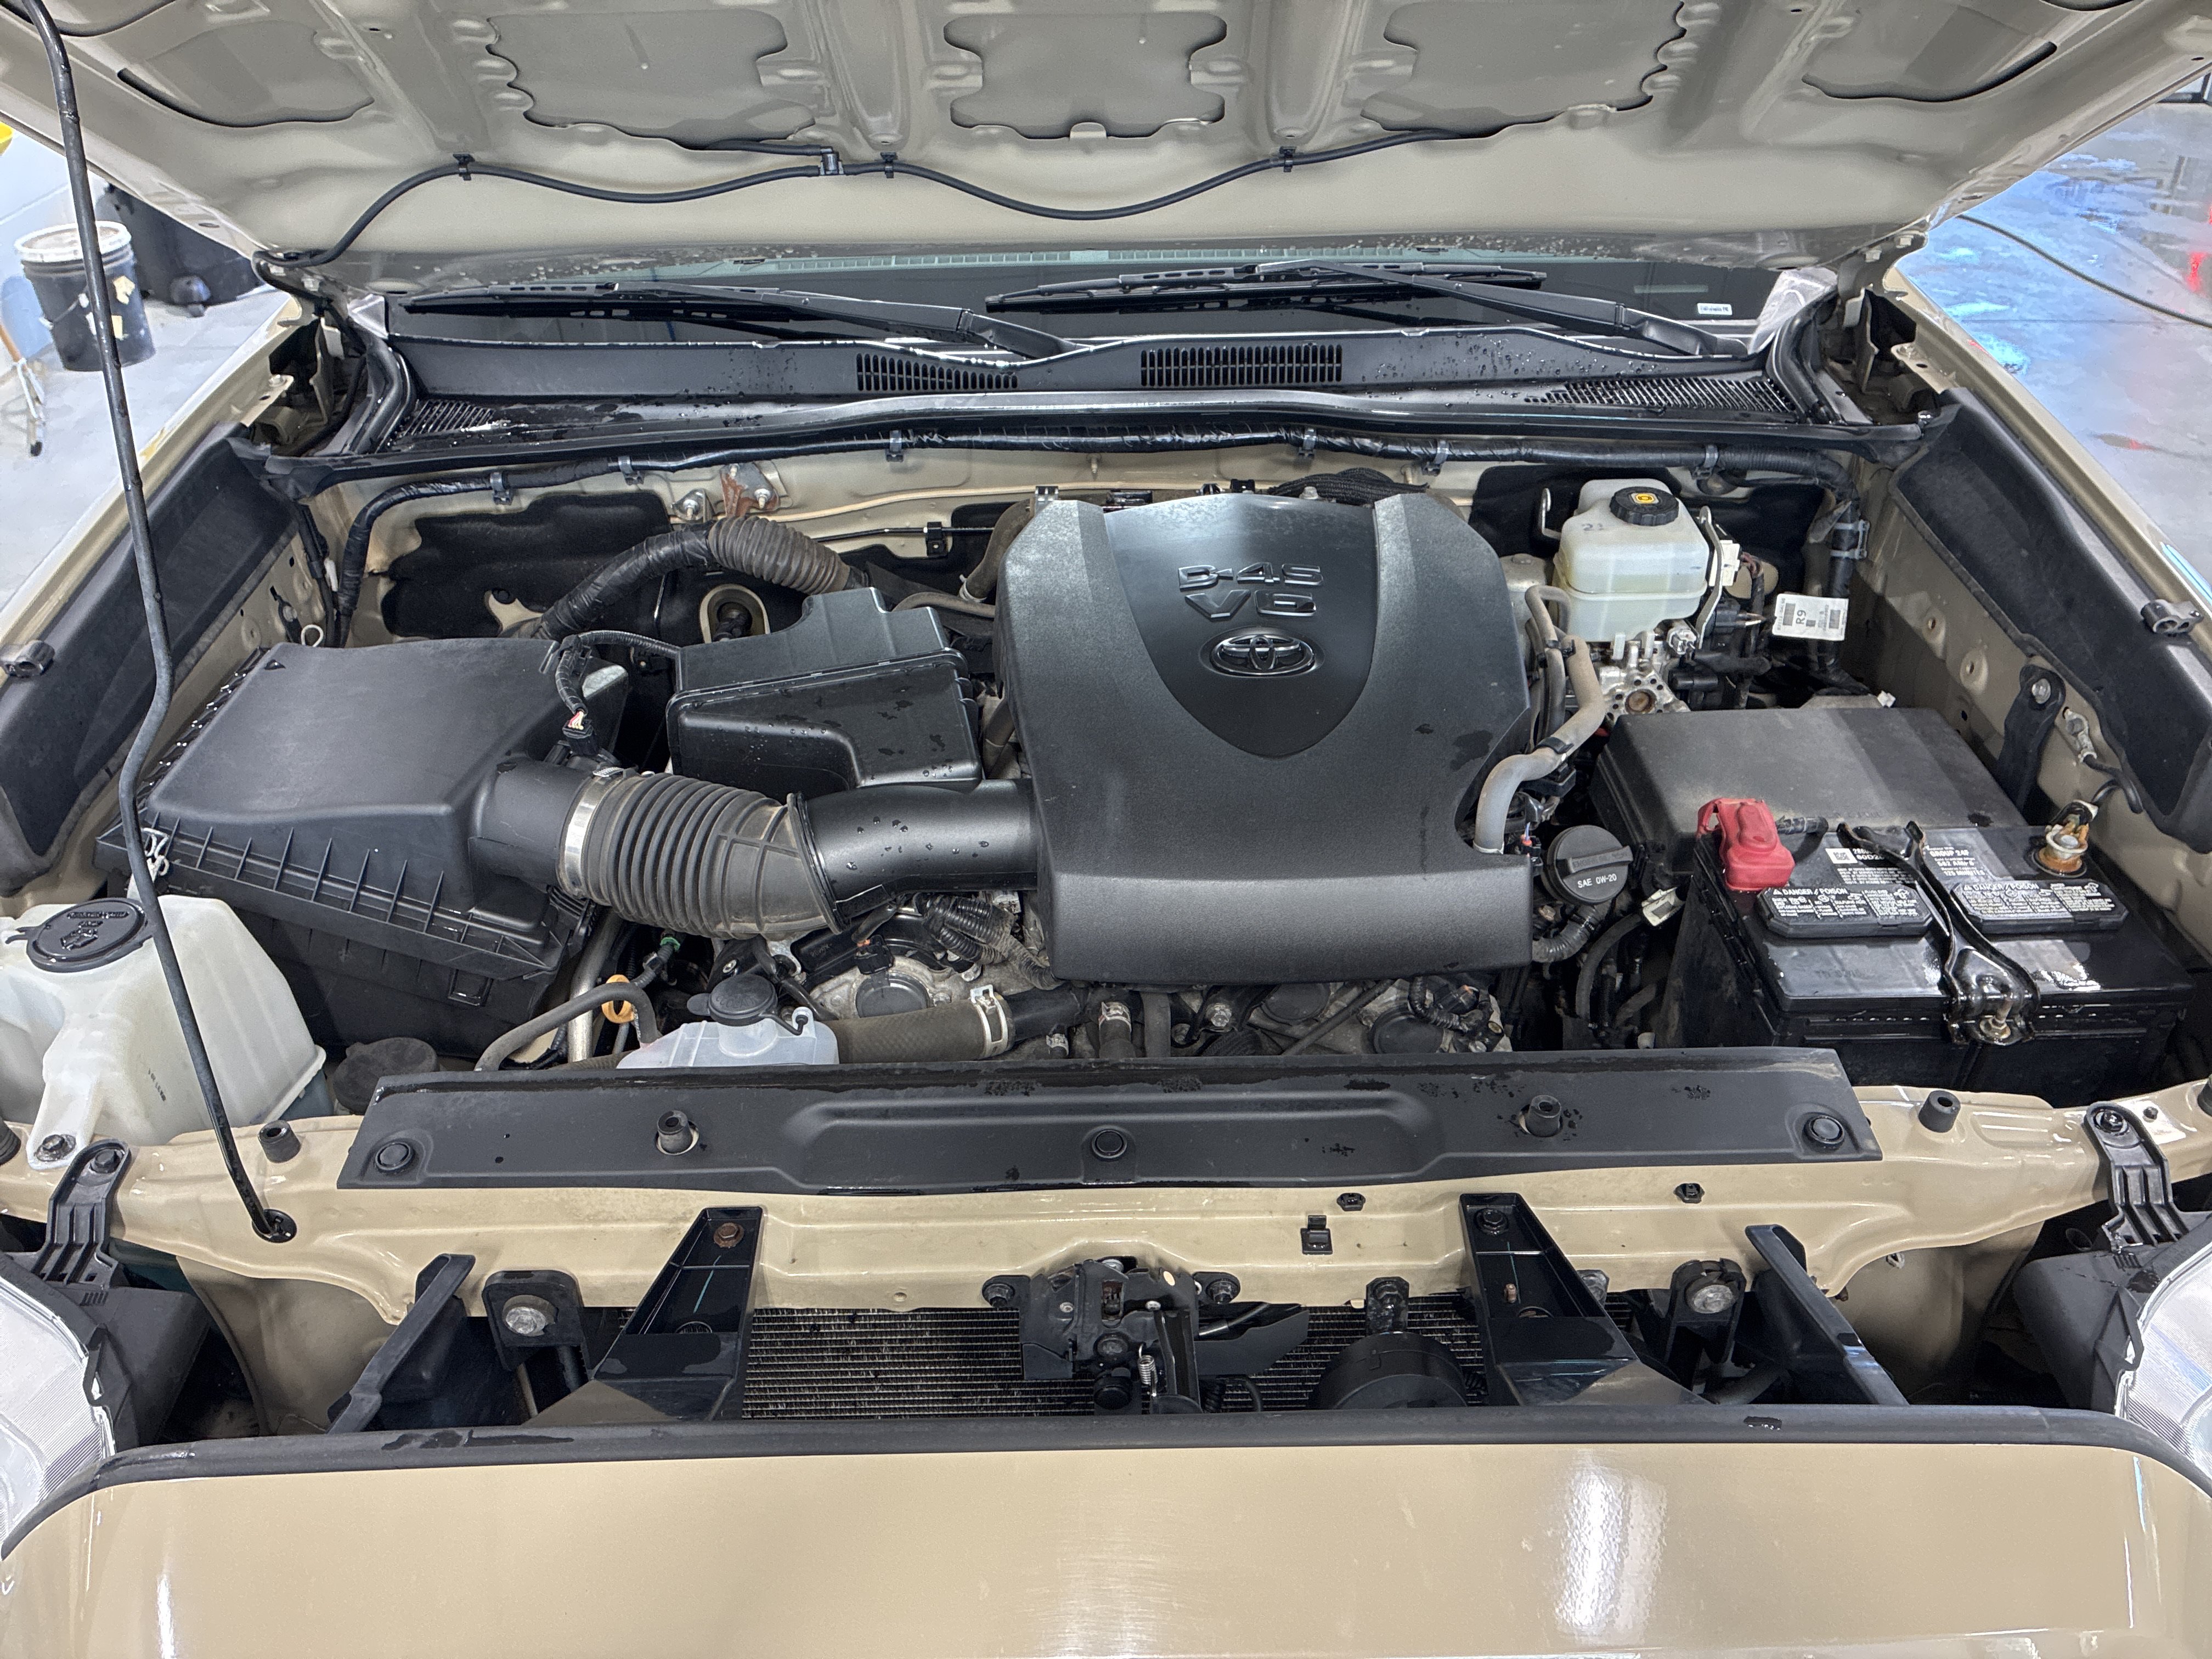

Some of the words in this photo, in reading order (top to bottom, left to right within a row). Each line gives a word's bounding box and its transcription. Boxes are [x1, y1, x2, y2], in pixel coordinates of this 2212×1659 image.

[1185, 589, 1316, 621] V6
[1796, 610, 1806, 625] R9
[1577, 878, 1593, 888] SAE
[1595, 873, 1617, 884] 0W-20
